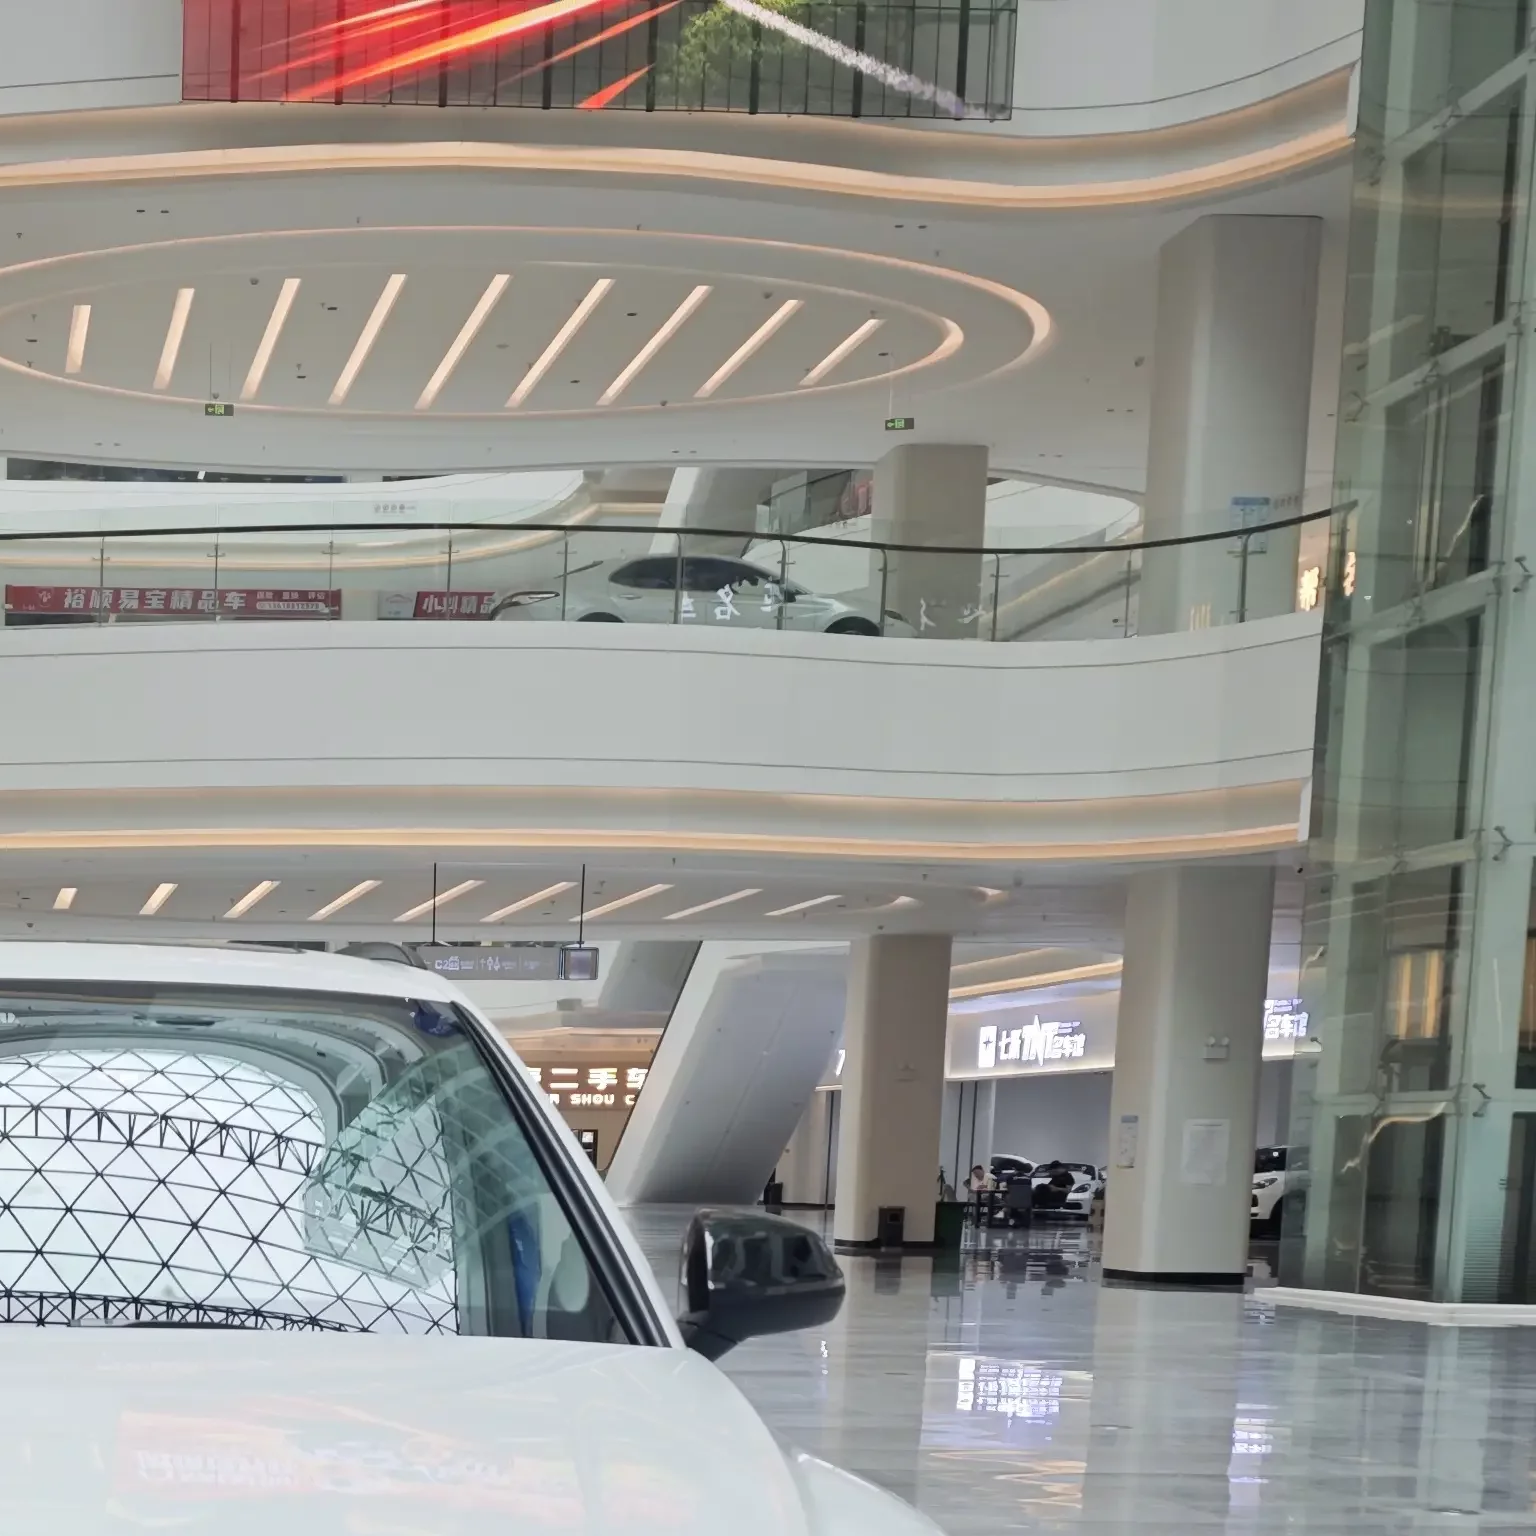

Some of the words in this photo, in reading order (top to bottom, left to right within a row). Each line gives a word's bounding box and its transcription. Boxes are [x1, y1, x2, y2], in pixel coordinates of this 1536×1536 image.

[64, 588, 247, 612] 裕顺易宝精品车
[569, 1093, 615, 1106] SHOU
